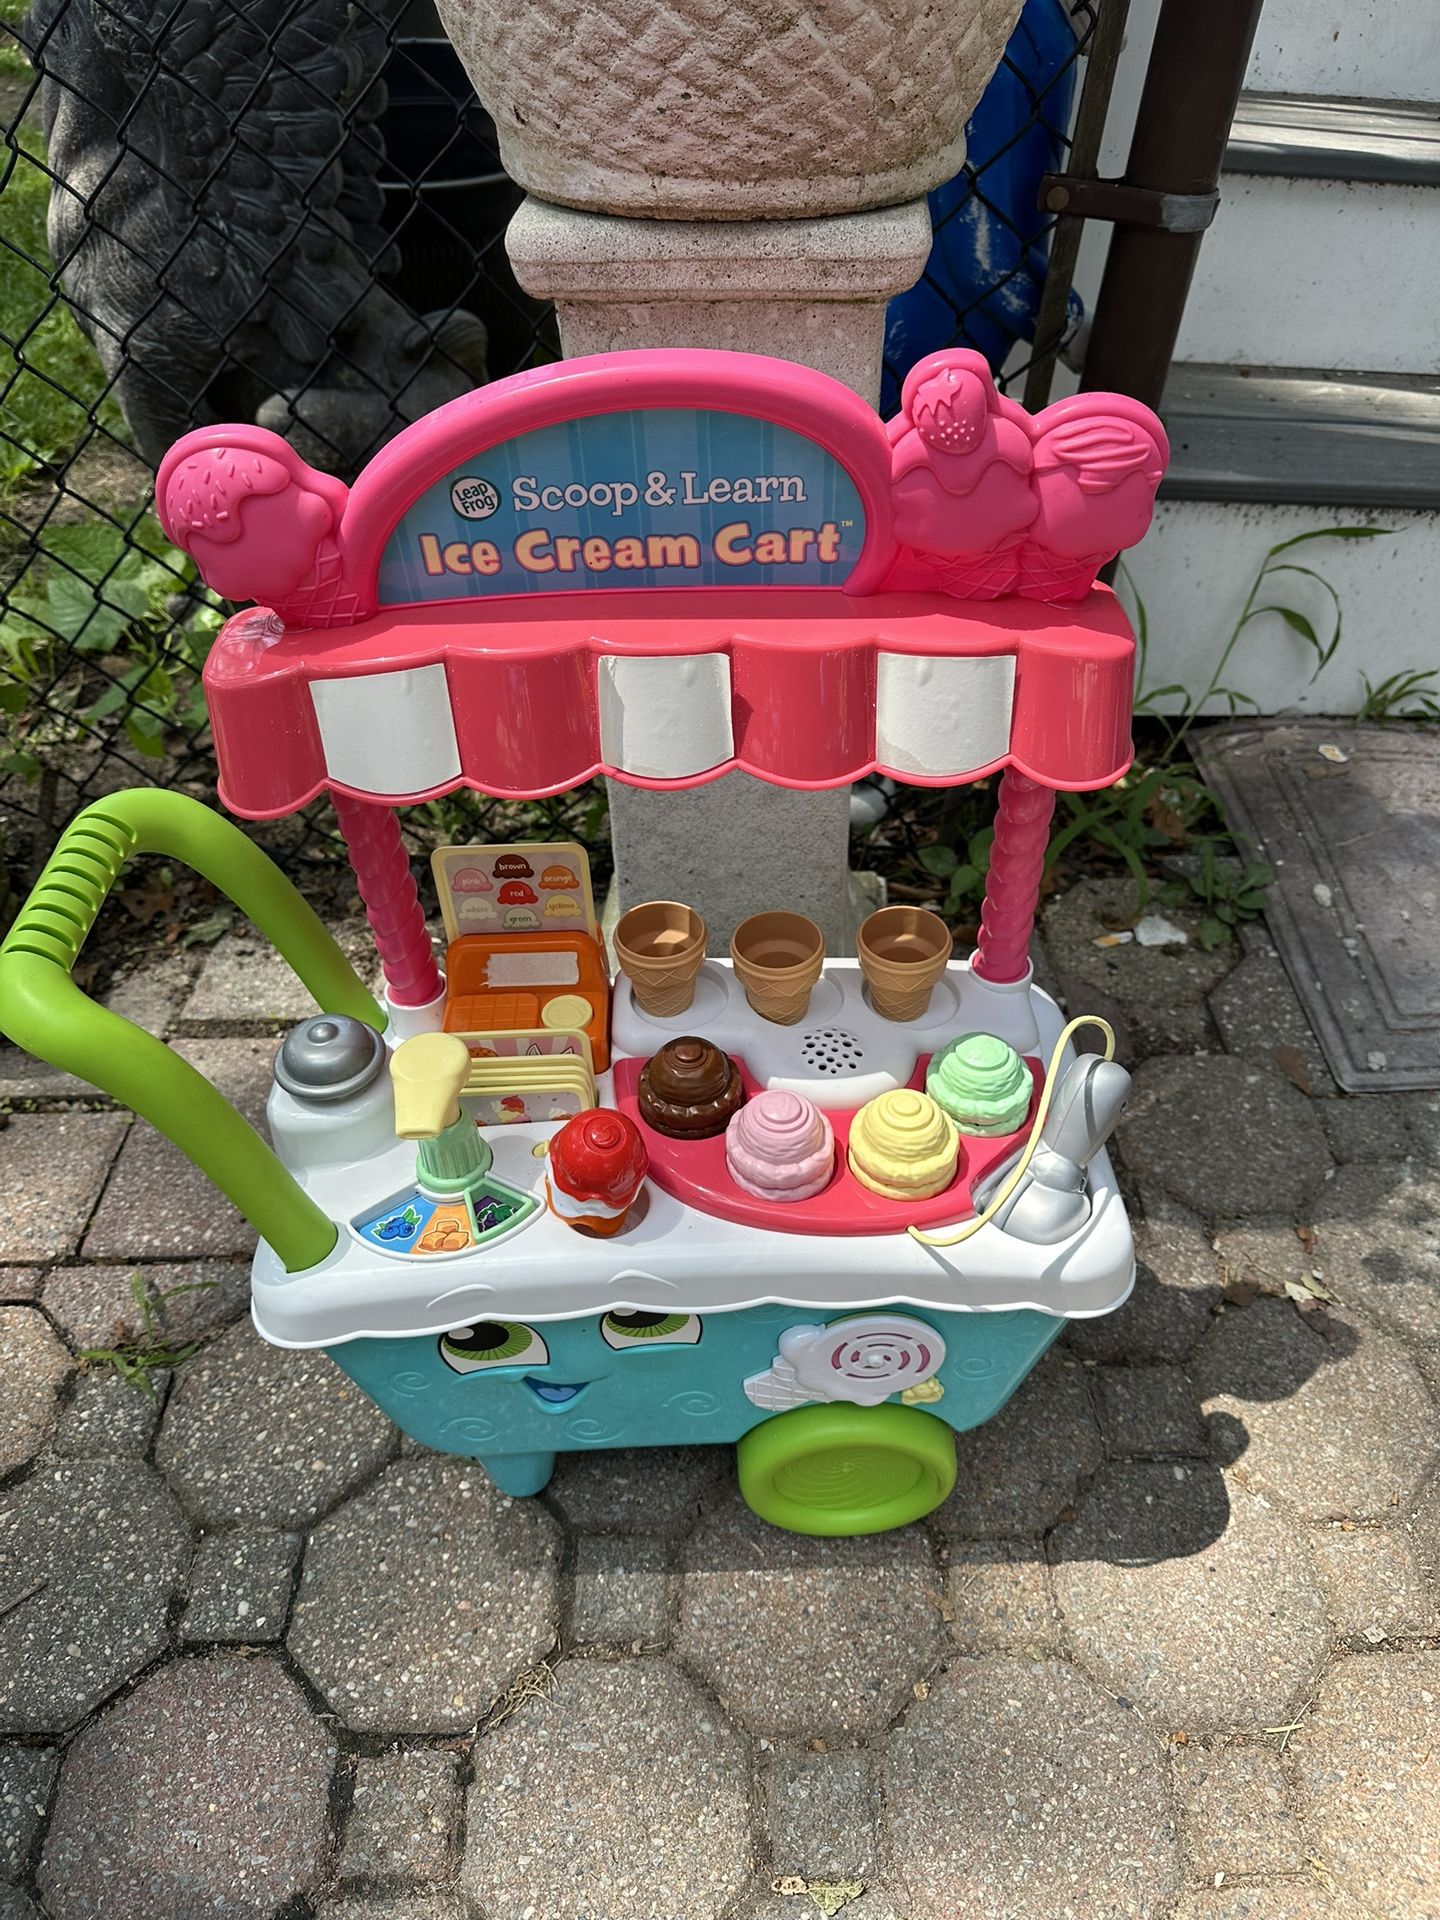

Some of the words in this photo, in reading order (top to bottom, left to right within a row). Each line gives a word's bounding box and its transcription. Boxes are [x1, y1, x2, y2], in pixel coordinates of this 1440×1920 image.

[454, 482, 488, 502] Leap
[512, 476, 639, 517] Scoop
[643, 471, 677, 507] &
[680, 471, 807, 505] Learn
[461, 494, 495, 515] Frog
[419, 532, 501, 576] Ice
[513, 527, 701, 573] Cream
[712, 520, 841, 566] Cart
[498, 863, 527, 871] brown
[461, 877, 481, 886] pink
[544, 874, 573, 884] orange
[548, 902, 575, 912] yellow
[509, 915, 532, 925] green
